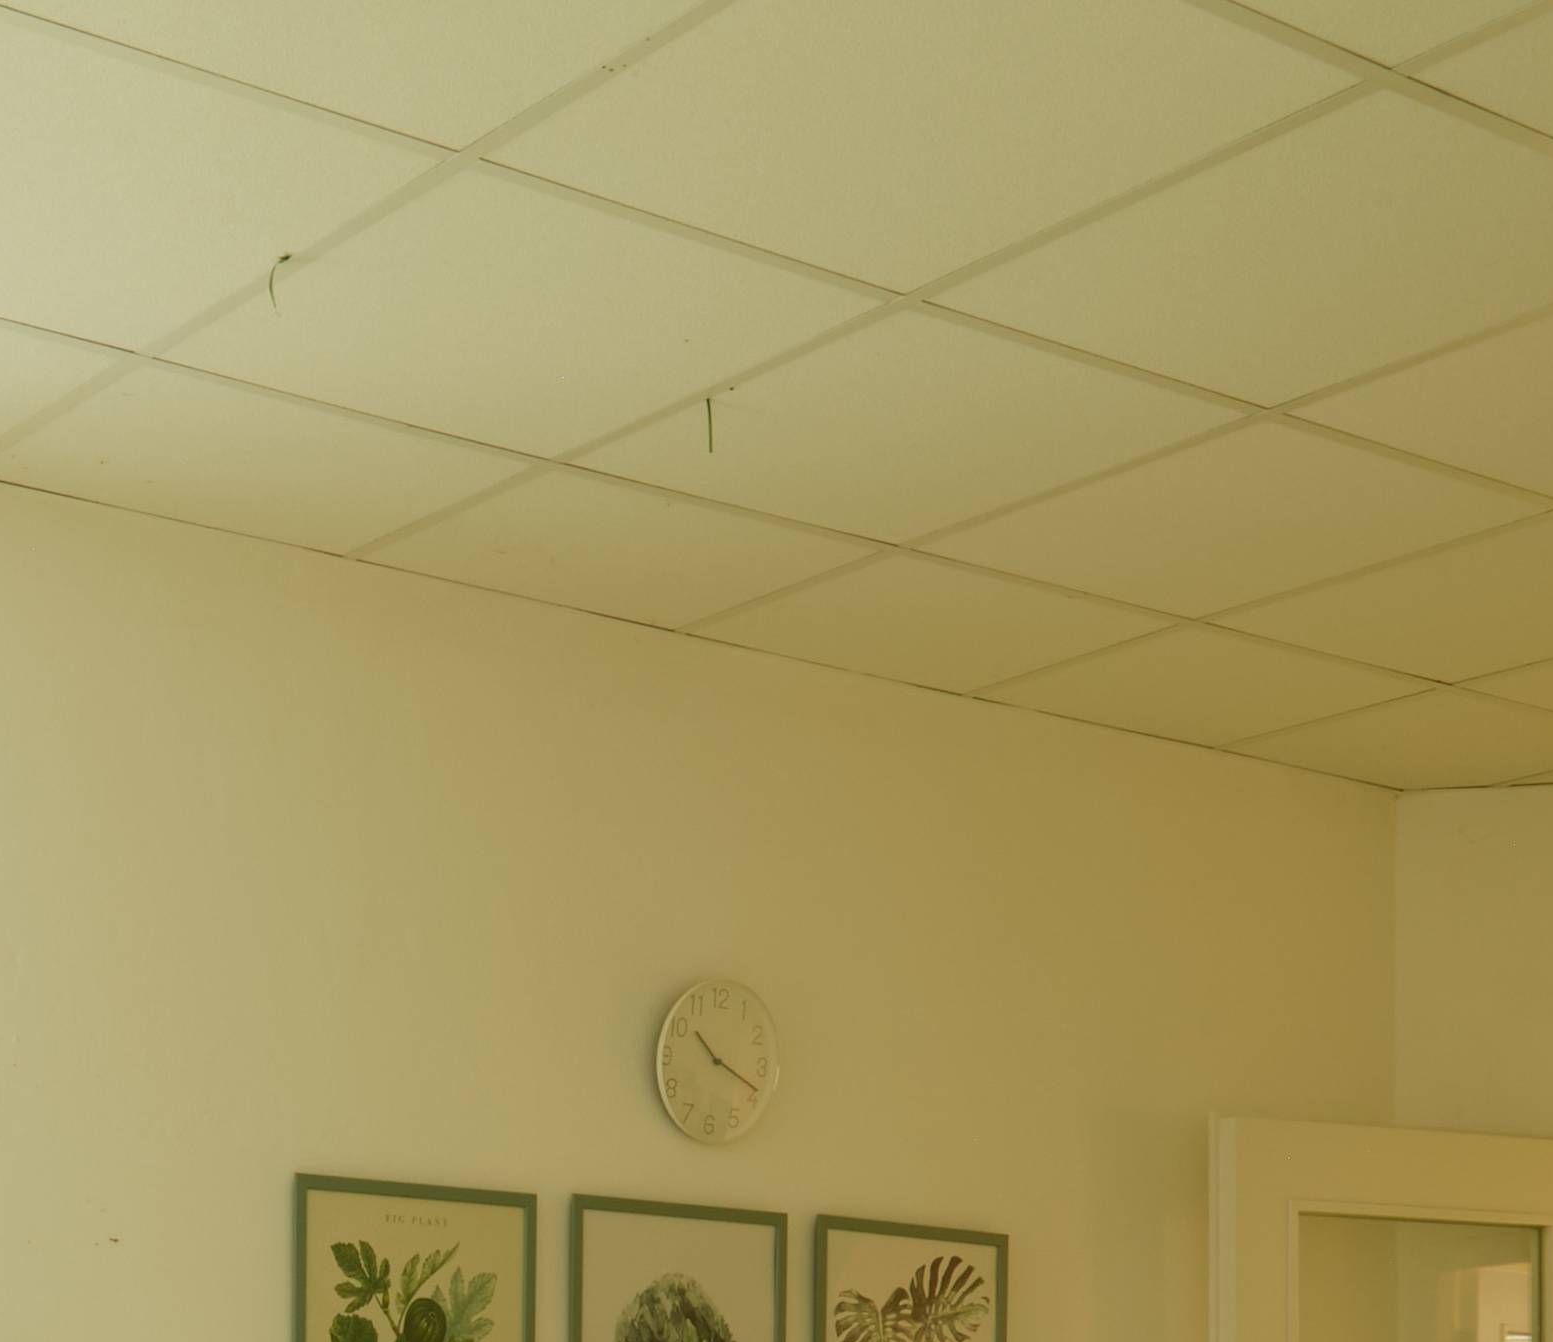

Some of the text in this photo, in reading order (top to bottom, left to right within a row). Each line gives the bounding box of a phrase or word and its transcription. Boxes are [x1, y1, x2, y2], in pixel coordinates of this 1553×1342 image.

[690, 994, 704, 1016] 11
[712, 987, 730, 1010] 12
[671, 1015, 688, 1038] 10
[751, 1025, 764, 1046] 2
[662, 1045, 673, 1066] 9
[756, 1057, 768, 1078] 3
[665, 1078, 678, 1098] 8
[682, 1102, 695, 1125] 7
[727, 1107, 741, 1129] 5
[703, 1114, 716, 1135] 6
